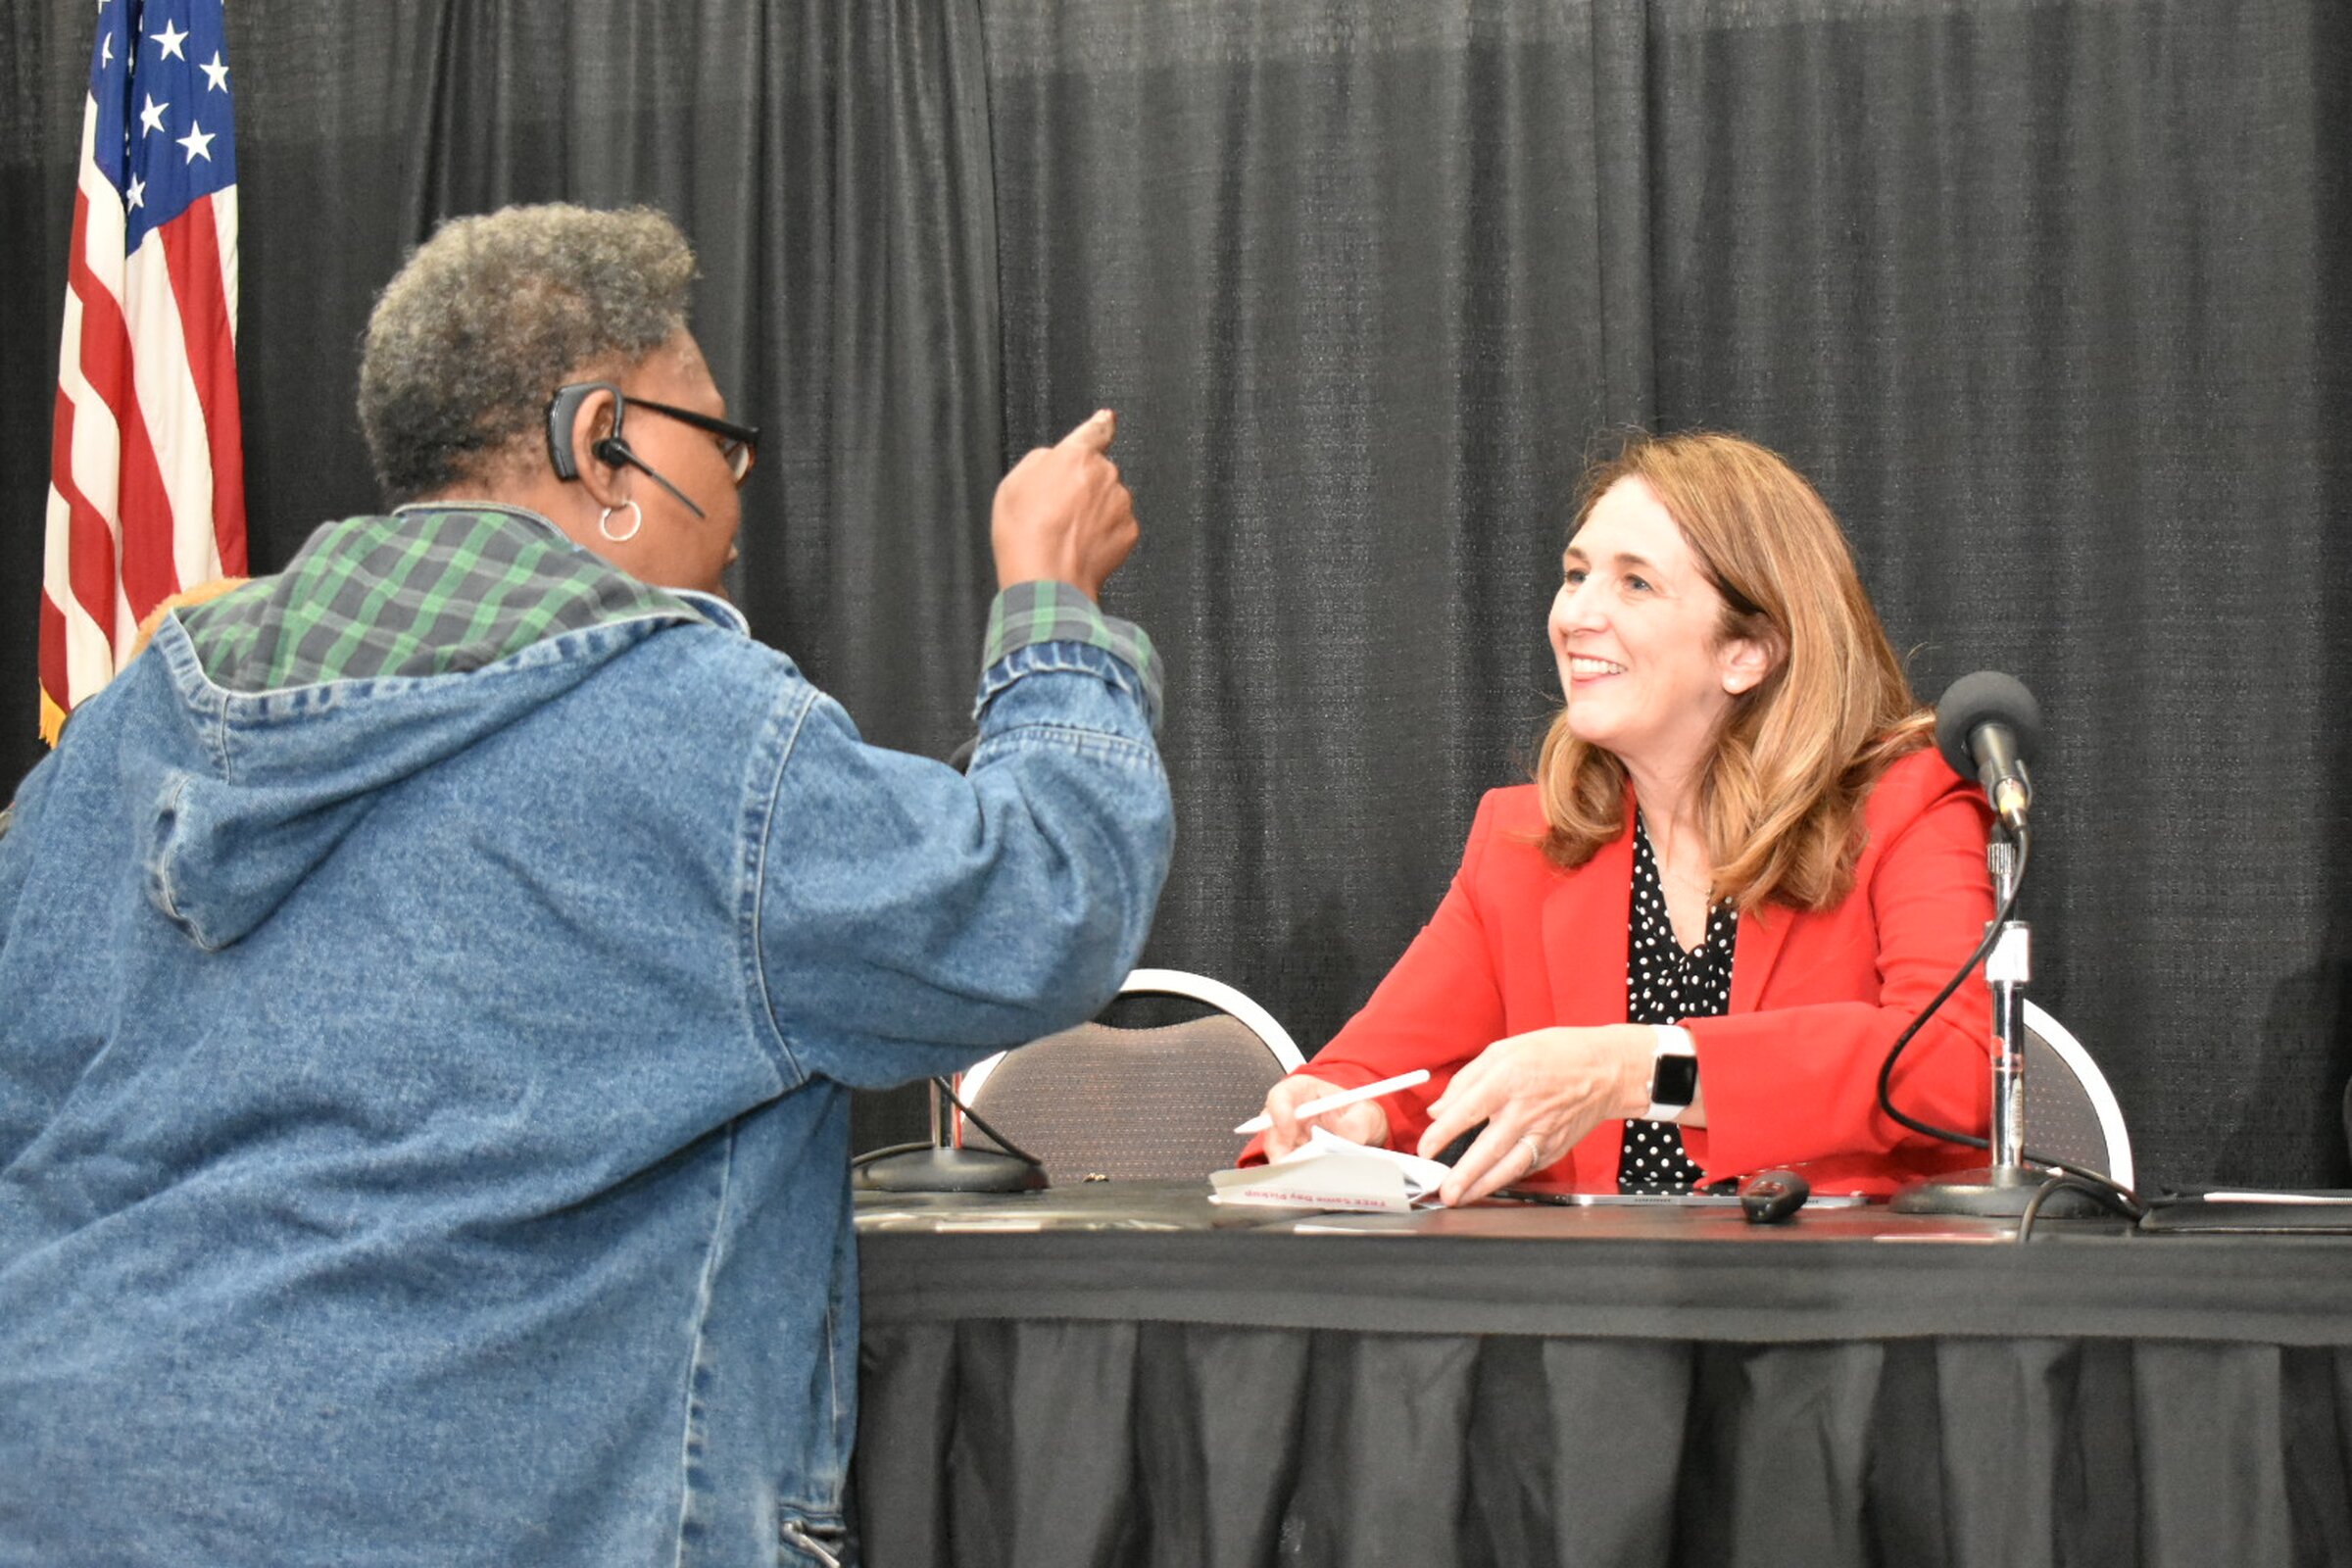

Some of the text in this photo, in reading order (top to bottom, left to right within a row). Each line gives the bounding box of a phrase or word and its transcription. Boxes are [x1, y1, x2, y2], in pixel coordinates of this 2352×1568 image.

[1244, 1190, 1287, 1200] Pickup
[1290, 1193, 1313, 1201] Day
[1354, 1198, 1386, 1206] FREE
